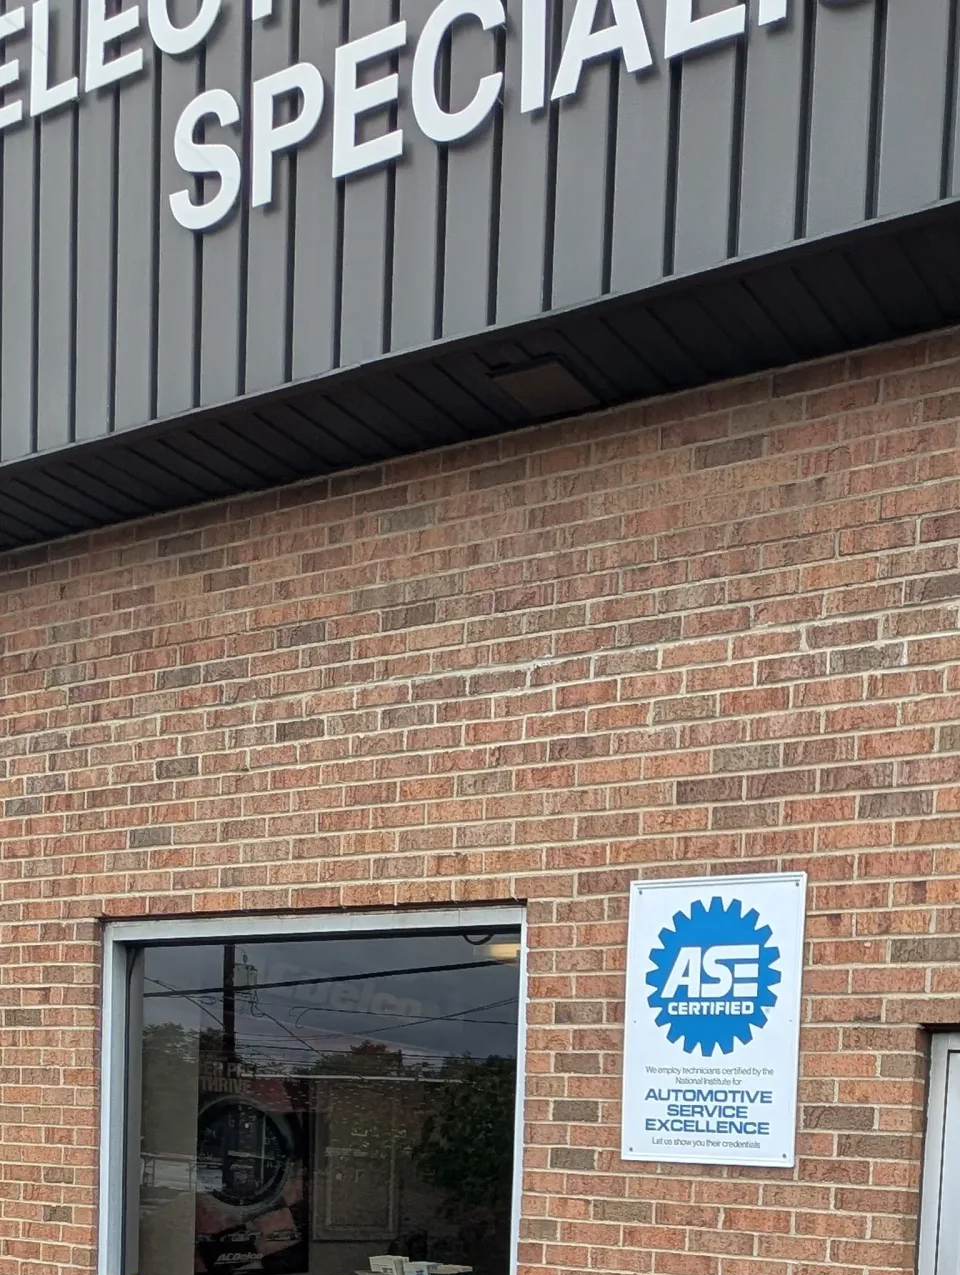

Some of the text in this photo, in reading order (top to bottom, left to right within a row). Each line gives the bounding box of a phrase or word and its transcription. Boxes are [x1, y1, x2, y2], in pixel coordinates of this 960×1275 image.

[660, 944, 760, 998] ASE
[667, 1001, 754, 1016] CERTIFIED
[658, 1067, 681, 1075] employ
[722, 1067, 752, 1075] certified
[752, 1067, 761, 1077] by
[675, 1077, 742, 1086] National Institute for
[644, 1088, 773, 1104] AUTOMOTIVE
[667, 1104, 748, 1119] SERVICE
[645, 1118, 770, 1135] EXCELLENCE
[652, 1137, 663, 1145] Let
[674, 1138, 691, 1146] show
[706, 1139, 721, 1147] their
